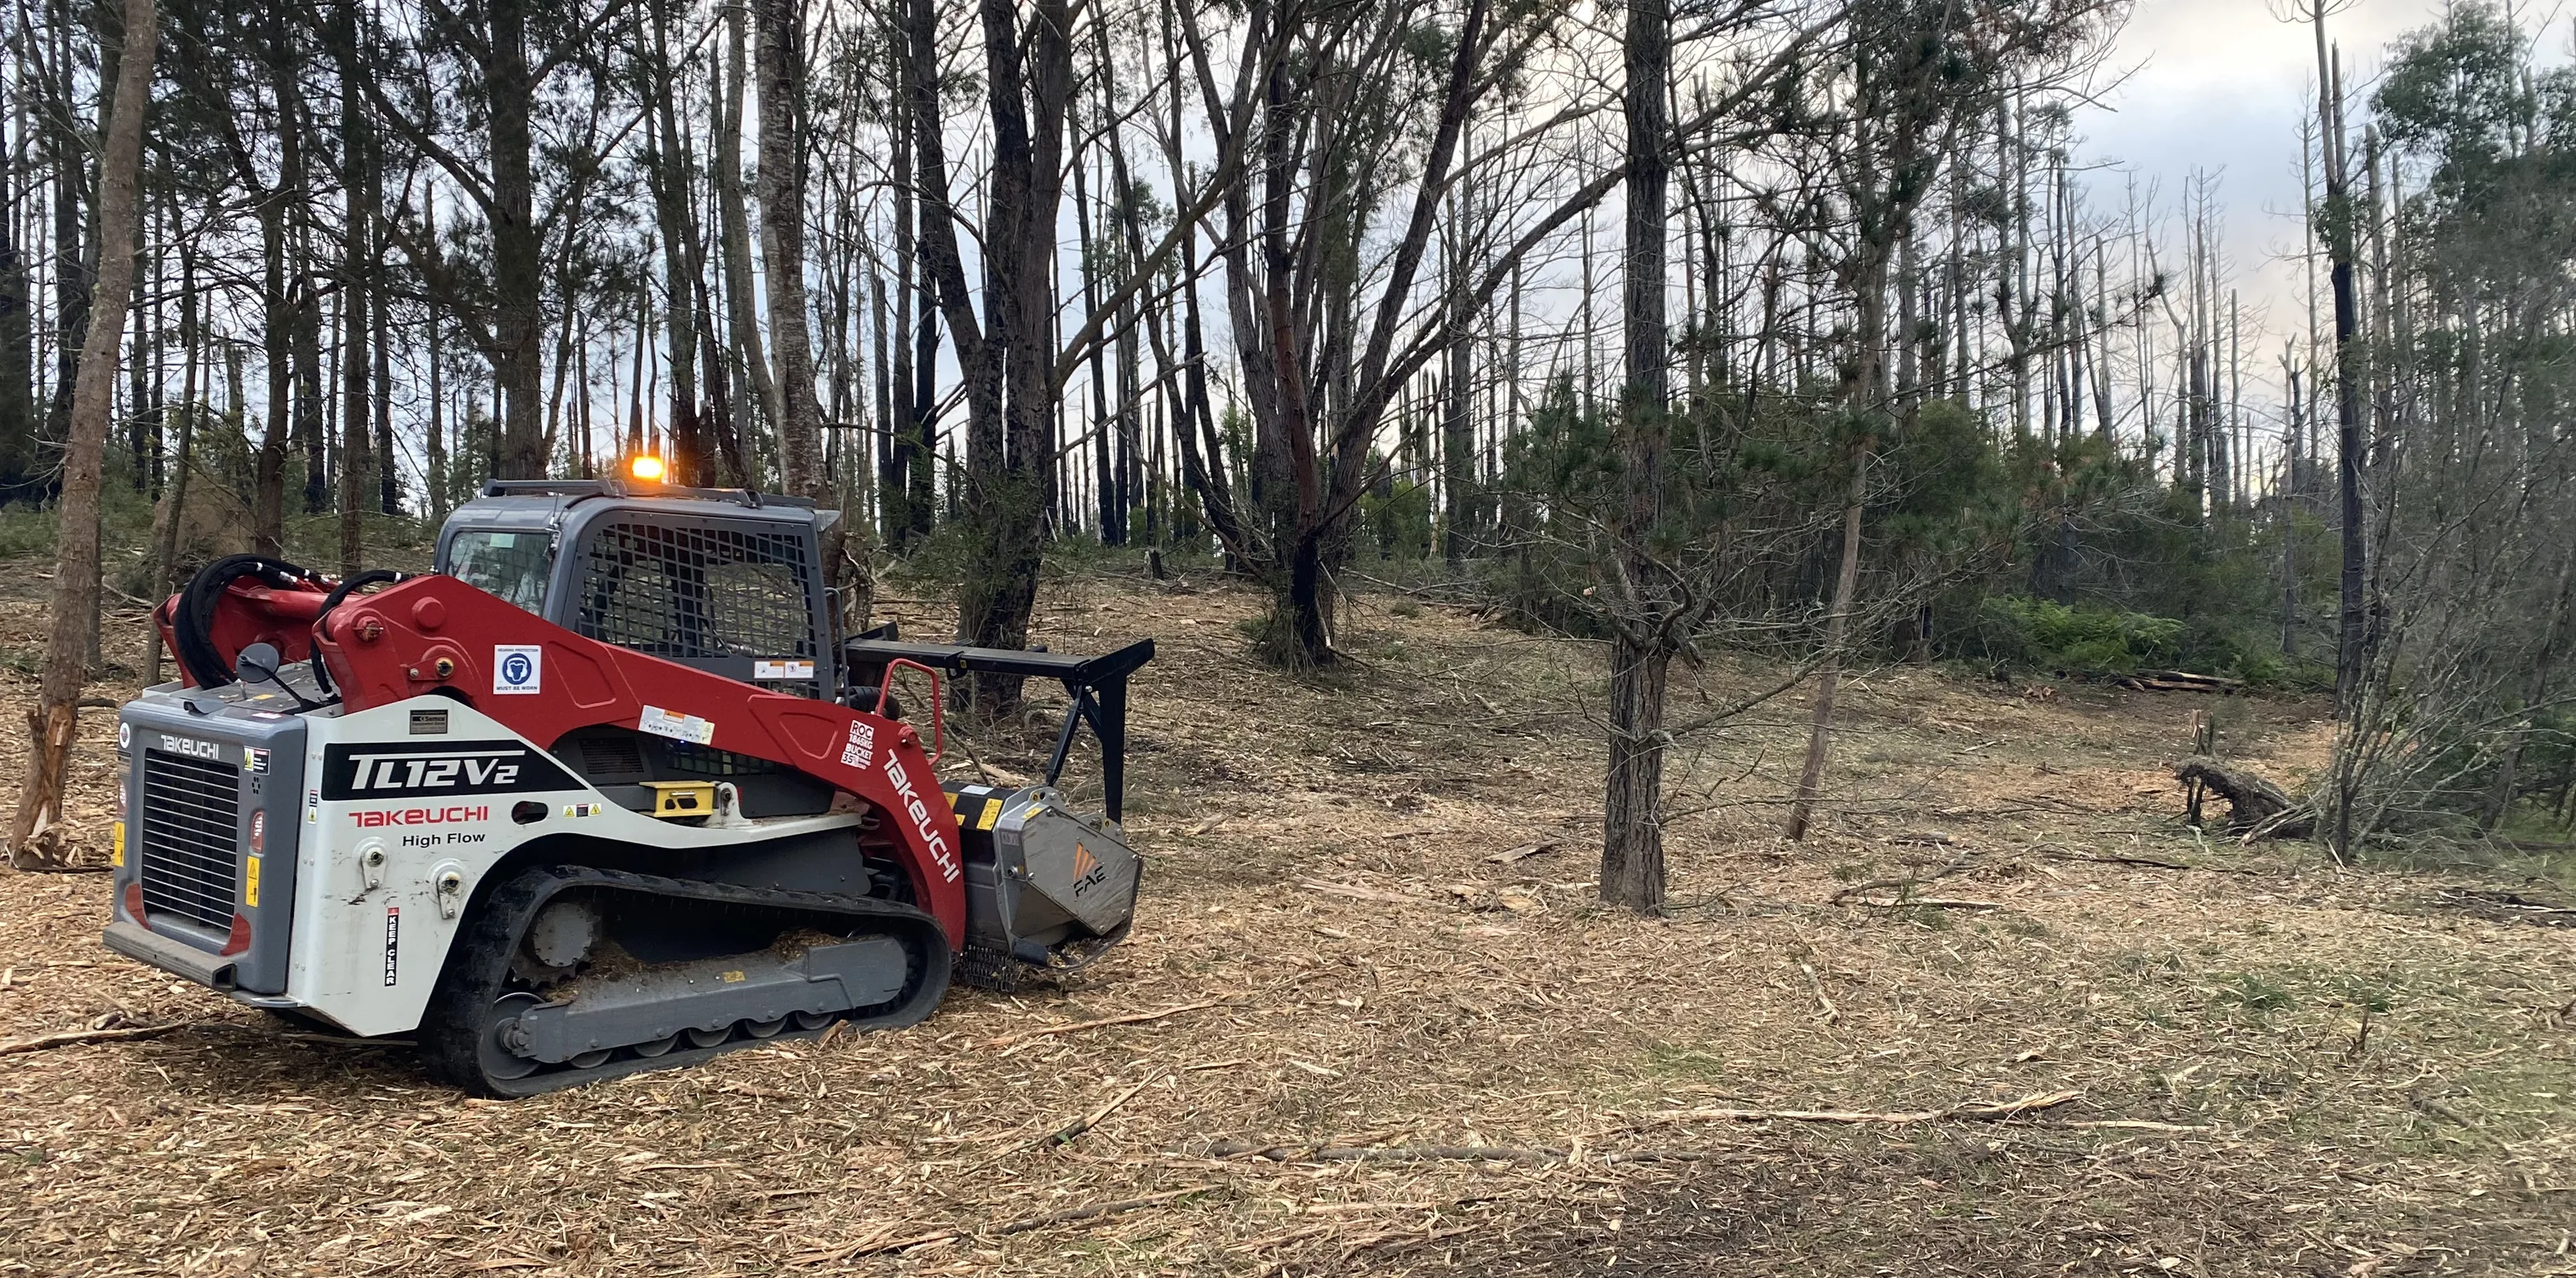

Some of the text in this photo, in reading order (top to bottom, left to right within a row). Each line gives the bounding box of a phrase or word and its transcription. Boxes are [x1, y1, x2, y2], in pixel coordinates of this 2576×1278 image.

[852, 722, 872, 739] ROC
[849, 734, 873, 750] 1865KG
[845, 743, 873, 761] BUCKET
[402, 833, 486, 848] High Flow
[1073, 866, 1106, 897] FAE
[386, 949, 395, 984] CLEAR
